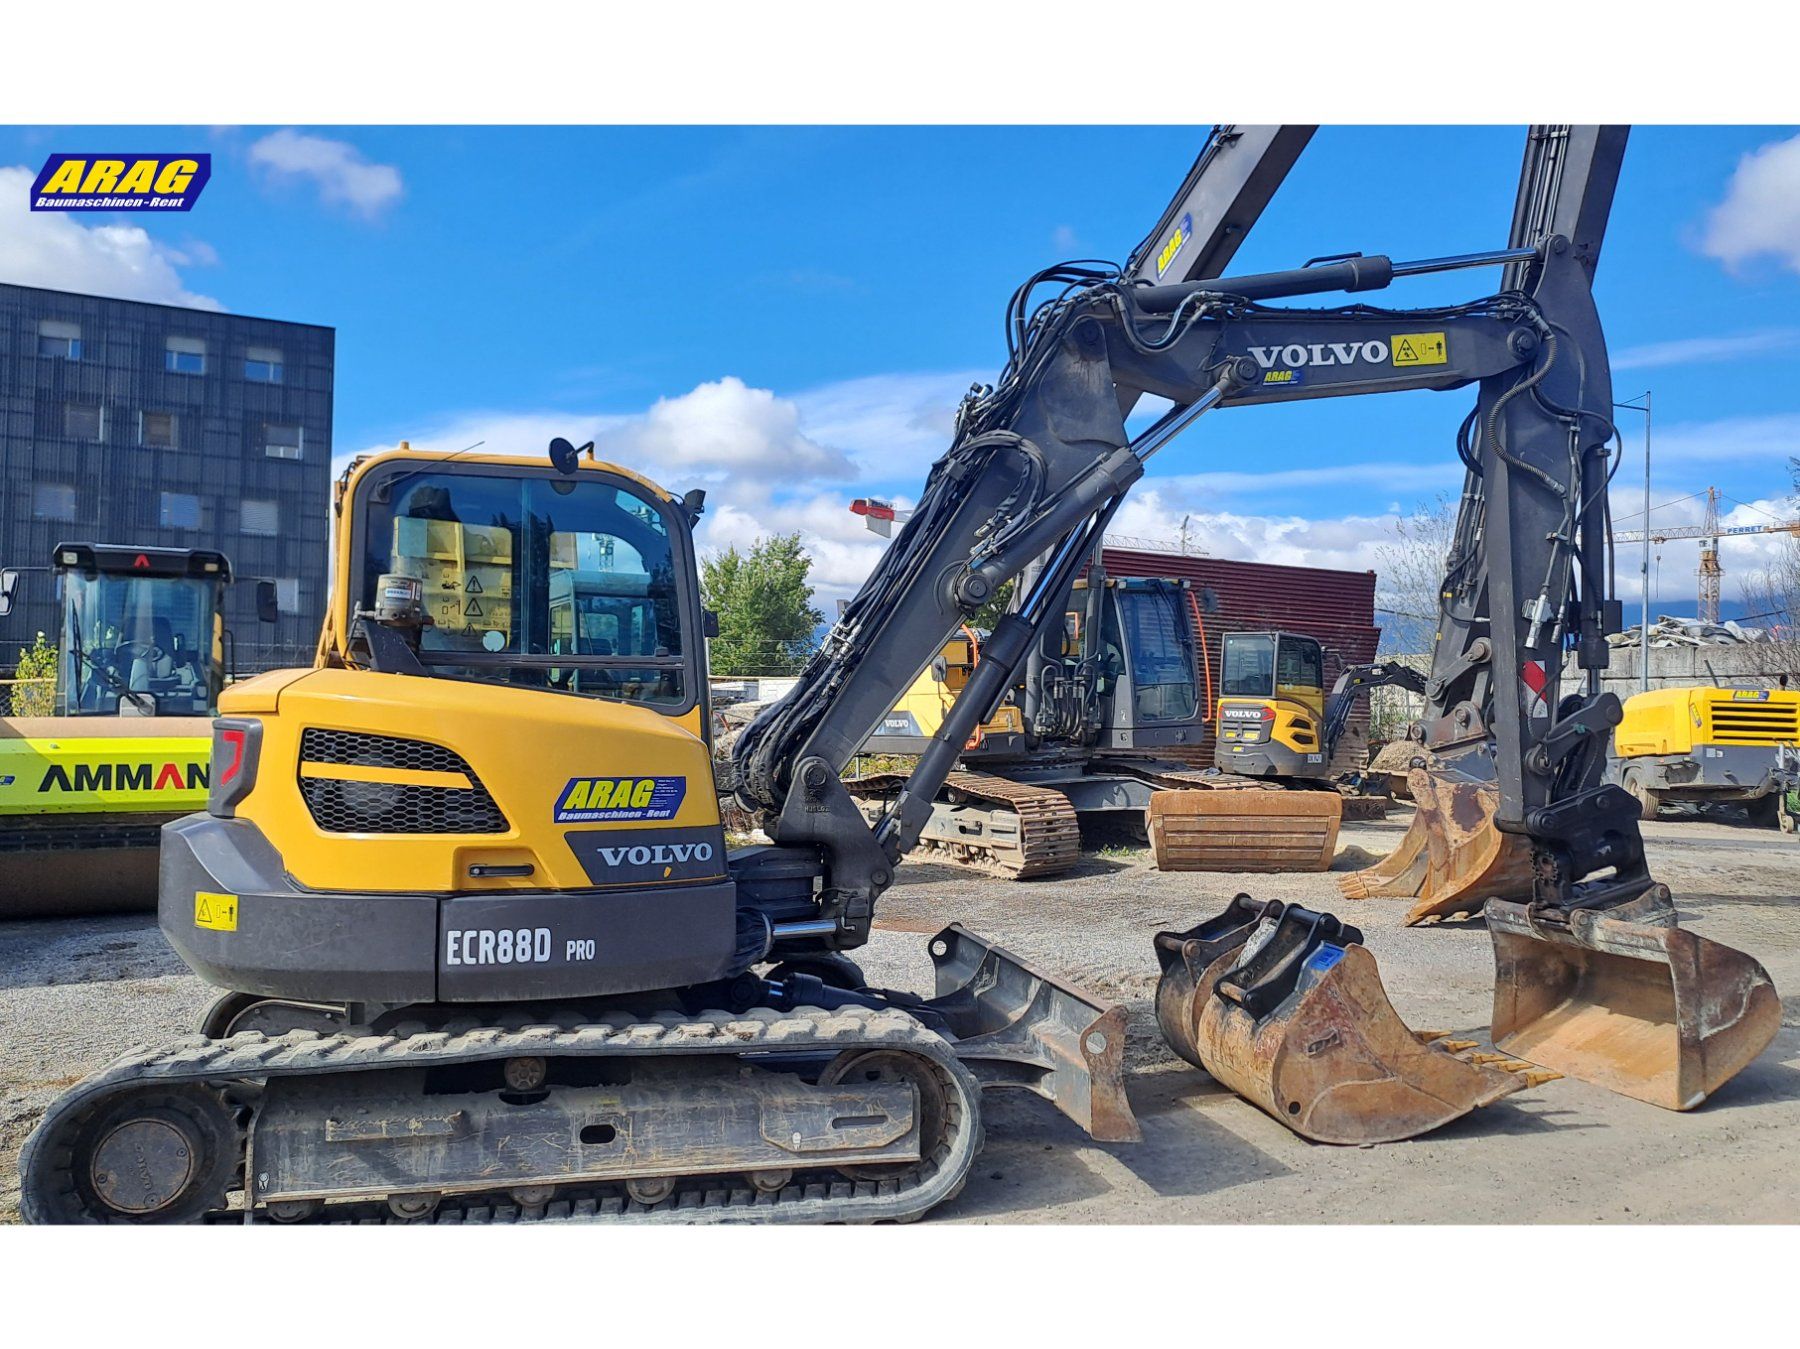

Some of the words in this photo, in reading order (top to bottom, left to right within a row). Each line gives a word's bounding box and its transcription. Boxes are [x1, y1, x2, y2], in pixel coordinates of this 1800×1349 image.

[1247, 340, 1389, 368] VOLVO
[1264, 370, 1293, 383] ARAG
[1727, 525, 1762, 534] PERRET
[884, 719, 909, 728] VOLVO
[1224, 710, 1261, 719] VOLVO
[562, 779, 656, 810] ARAG
[597, 842, 713, 867] VOLVO
[446, 928, 552, 966] ECR88D
[566, 940, 596, 962] PRO
